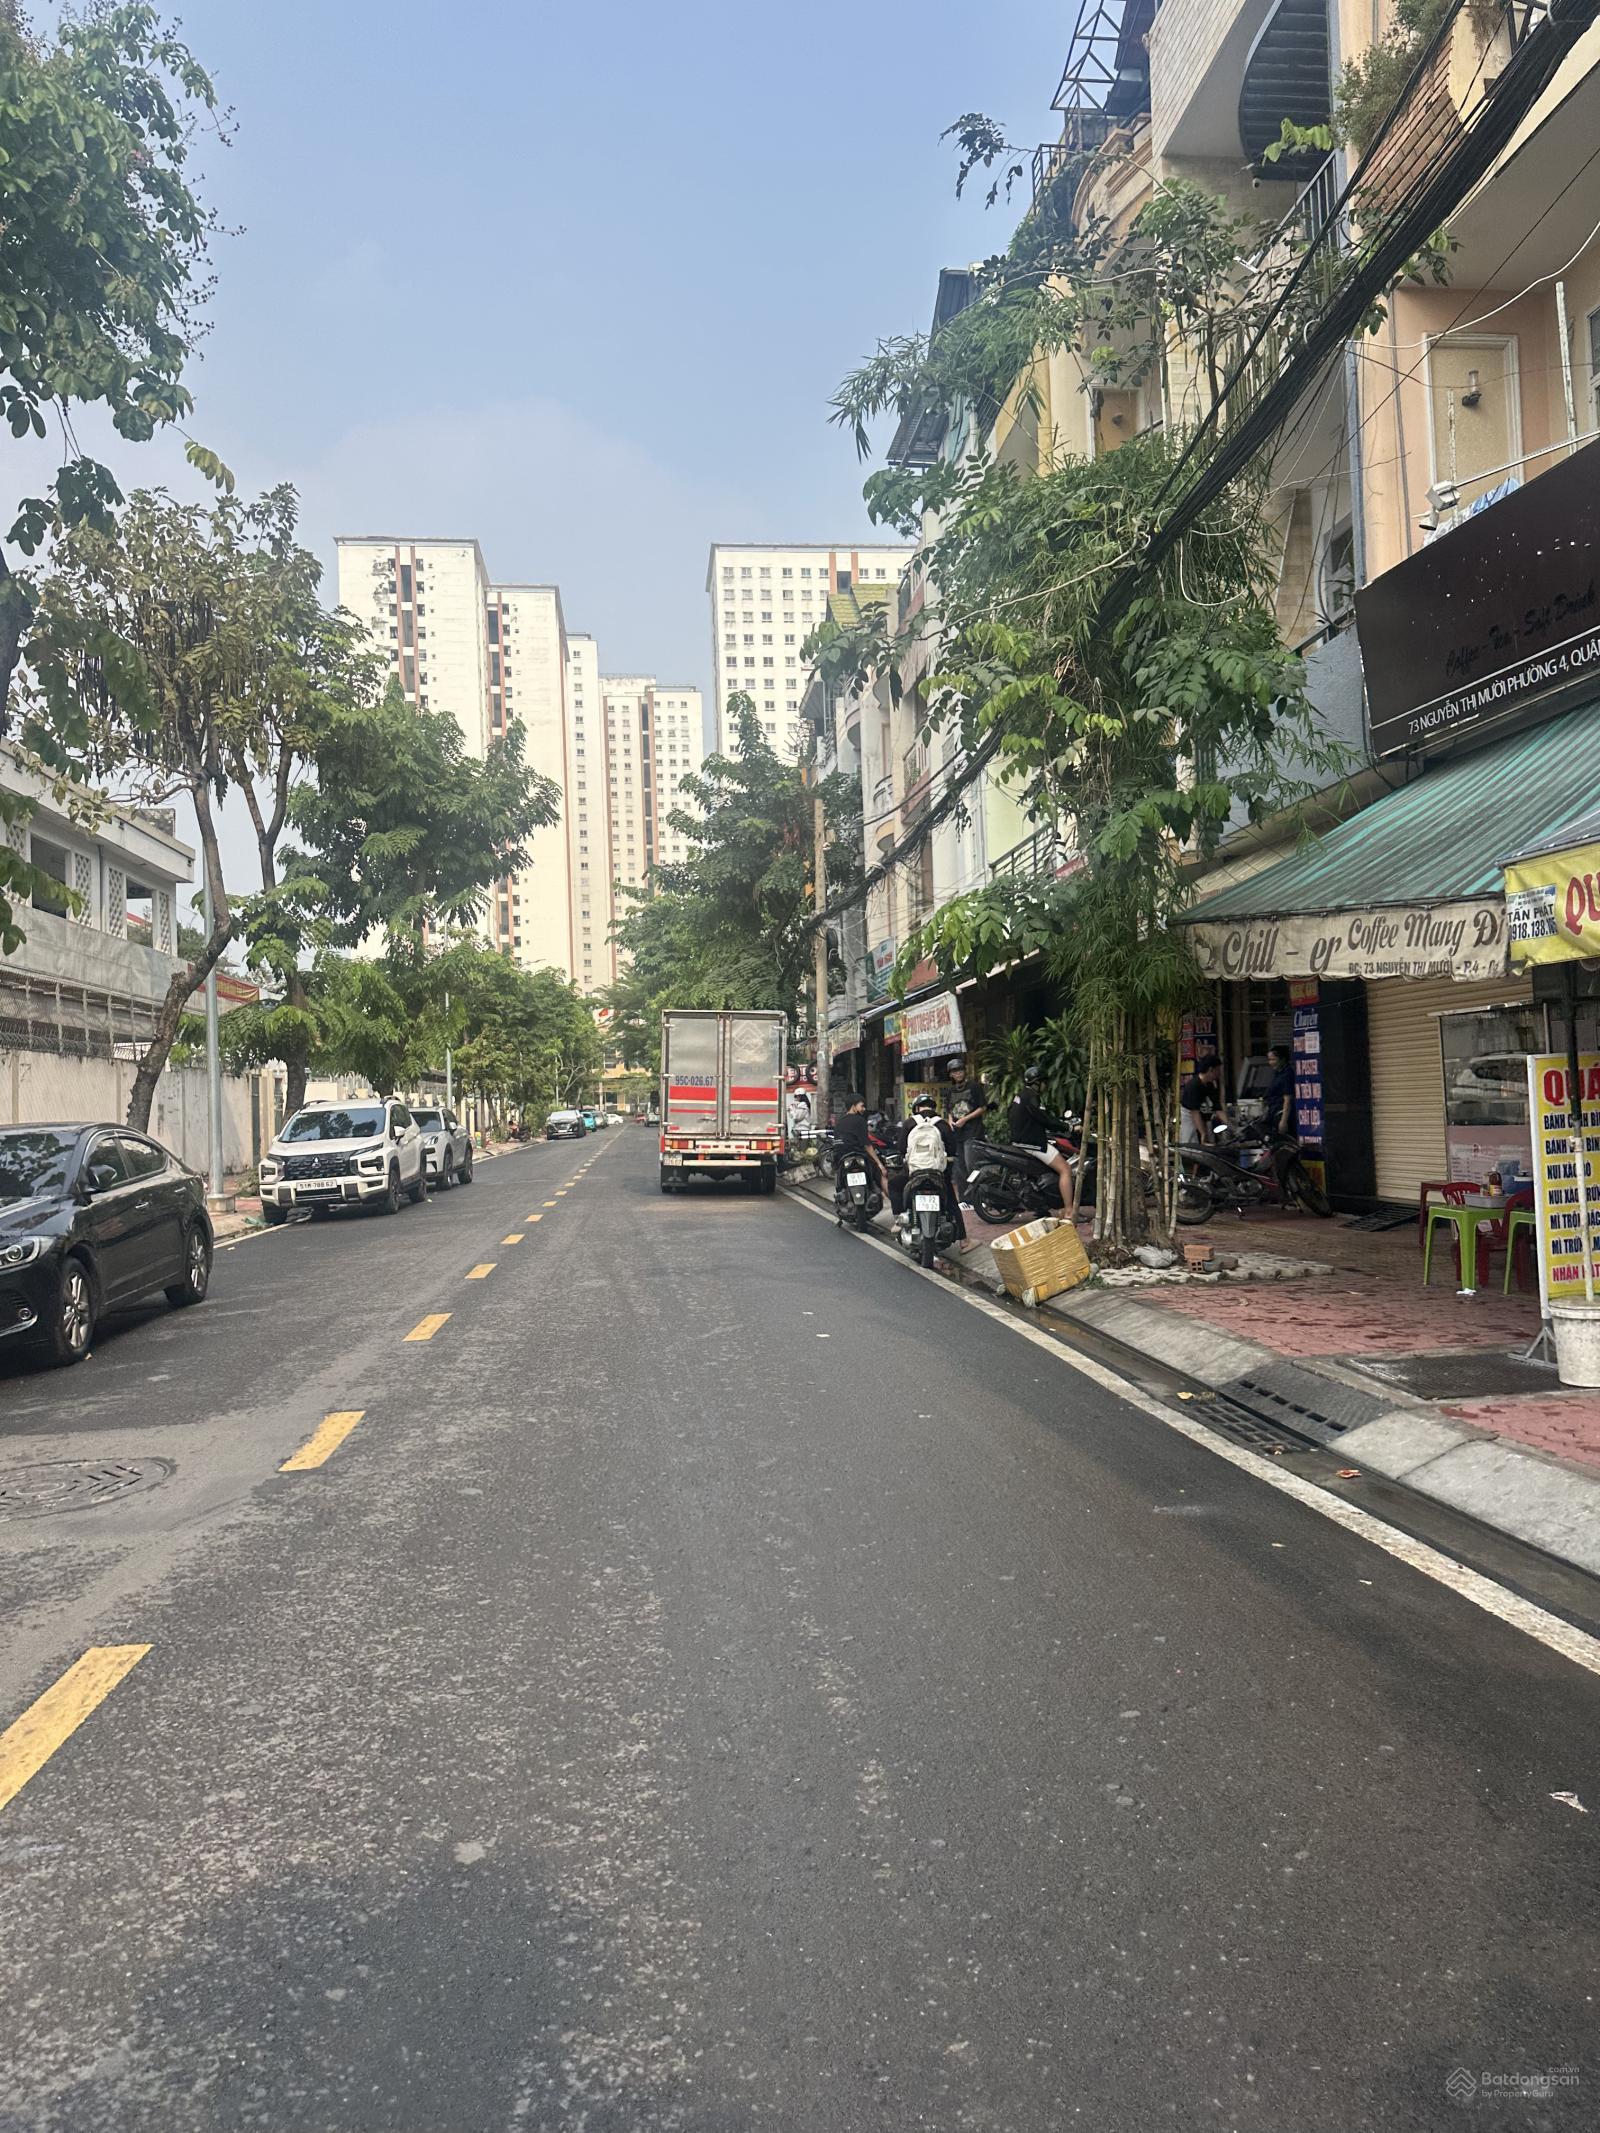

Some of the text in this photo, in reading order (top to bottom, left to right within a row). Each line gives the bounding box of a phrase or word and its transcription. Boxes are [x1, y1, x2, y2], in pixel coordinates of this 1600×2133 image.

[1408, 719, 1419, 735] 73
[1460, 694, 1477, 711] THỊ
[1478, 680, 1506, 706] MƯỜI
[1507, 659, 1557, 693] PHƯỜNG
[1559, 655, 1569, 672] 4,
[1348, 916, 1399, 955] Coffee
[1405, 912, 1466, 956] Mang
[1222, 927, 1279, 974] Chill
[1309, 936, 1342, 973] er
[1363, 962, 1374, 974] 73
[1544, 1113, 1566, 1130] BÁNH
[1545, 1139, 1567, 1155] BÁNH
[1547, 1164, 1563, 1180] NUI
[1549, 1189, 1563, 1205] NUI
[1550, 1211, 1560, 1230] MÌ
[1552, 1237, 1562, 1255] MÌ
[1552, 1264, 1579, 1283] NHẬN
